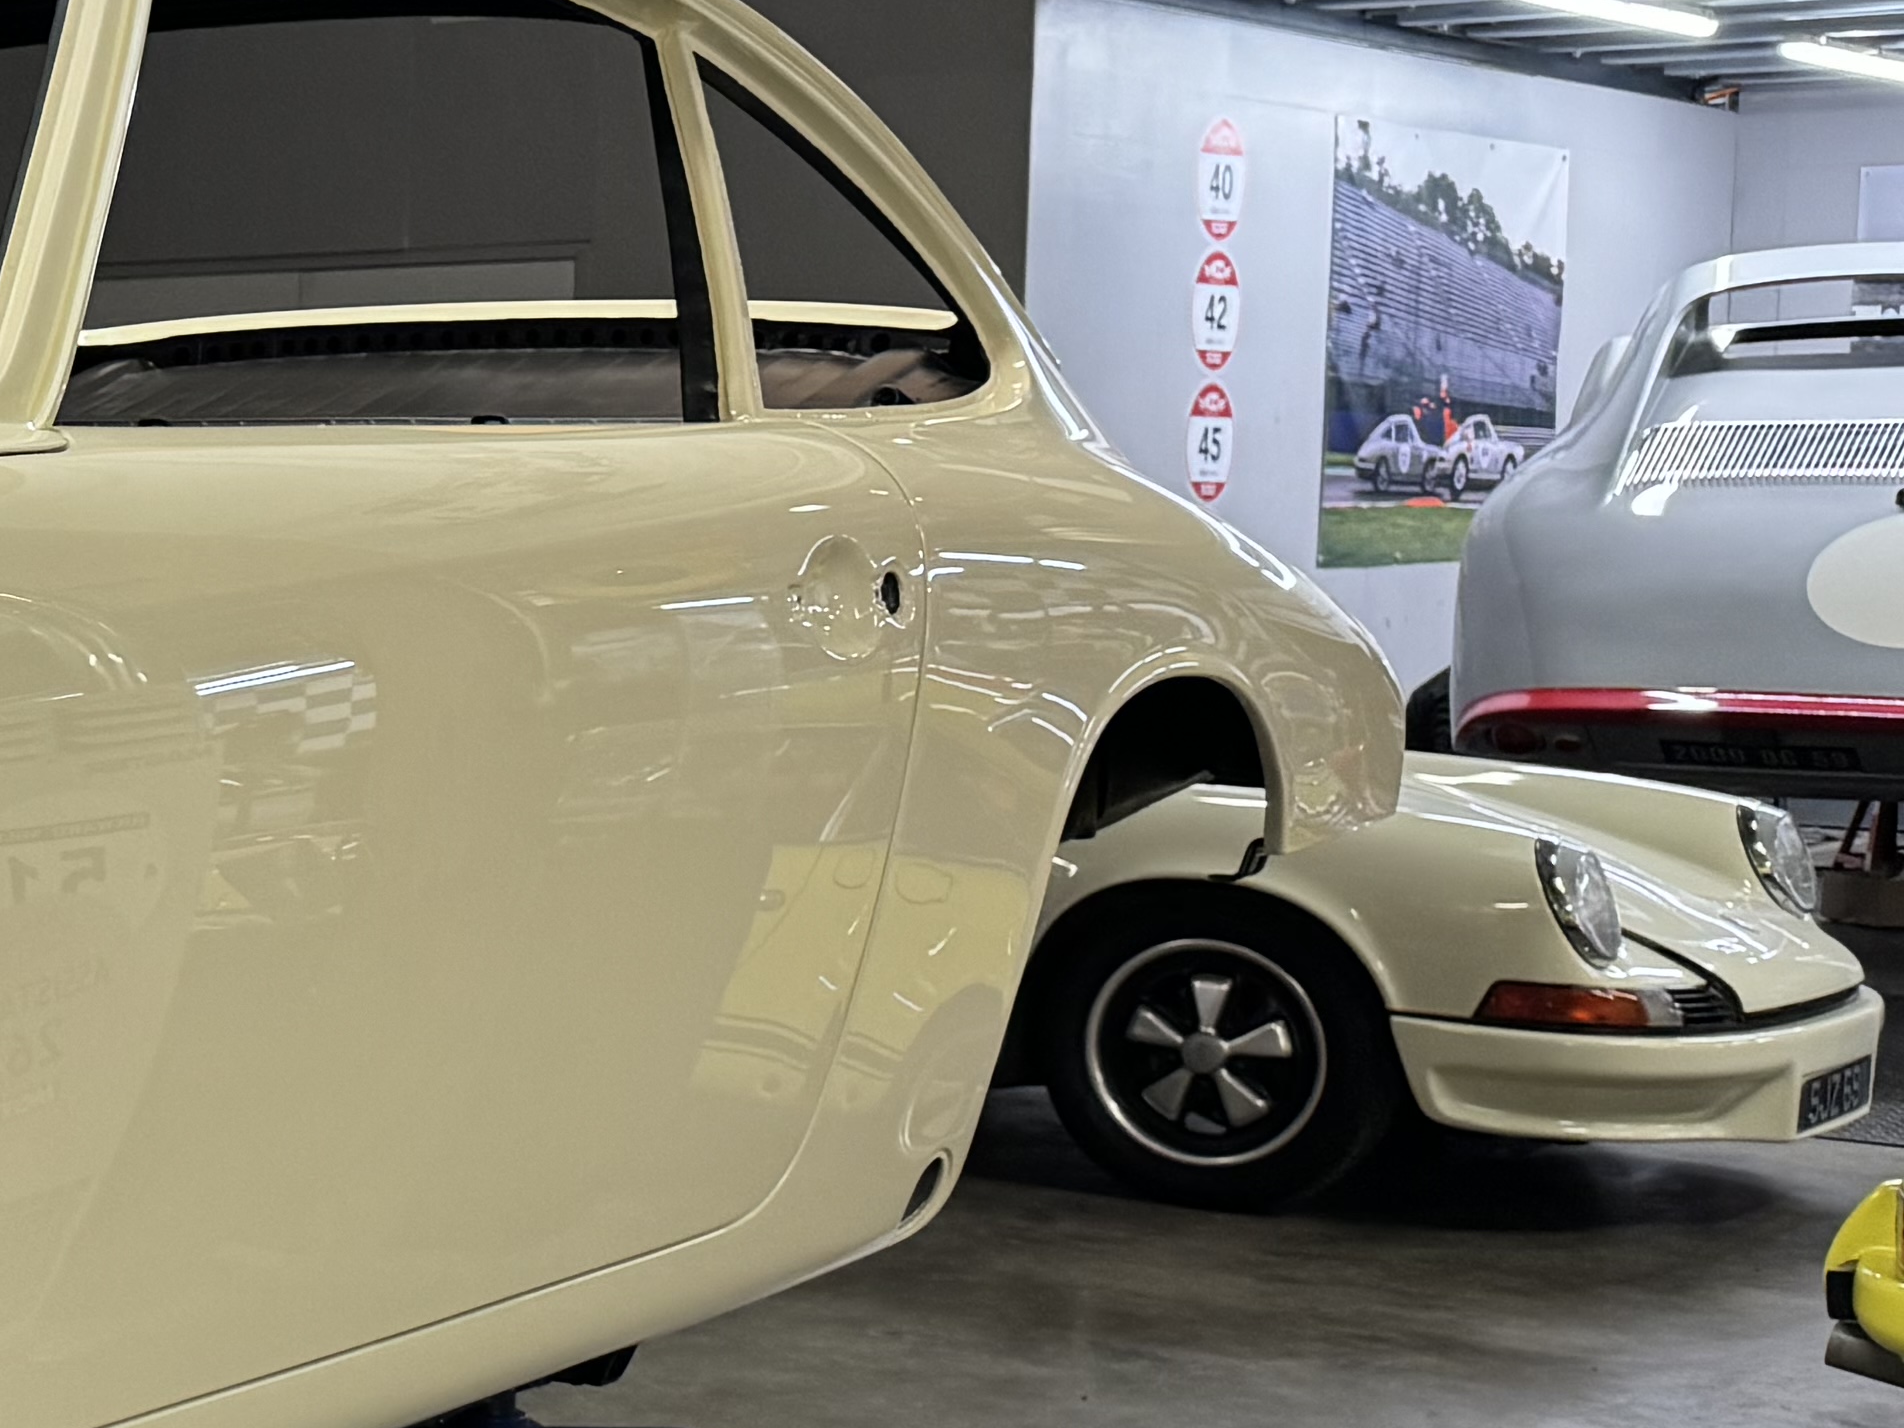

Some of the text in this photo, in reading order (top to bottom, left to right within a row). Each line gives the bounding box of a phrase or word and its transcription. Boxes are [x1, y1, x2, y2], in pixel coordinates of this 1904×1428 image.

[1210, 163, 1233, 201] 40
[1205, 293, 1227, 330] 42
[1199, 426, 1222, 462] 45
